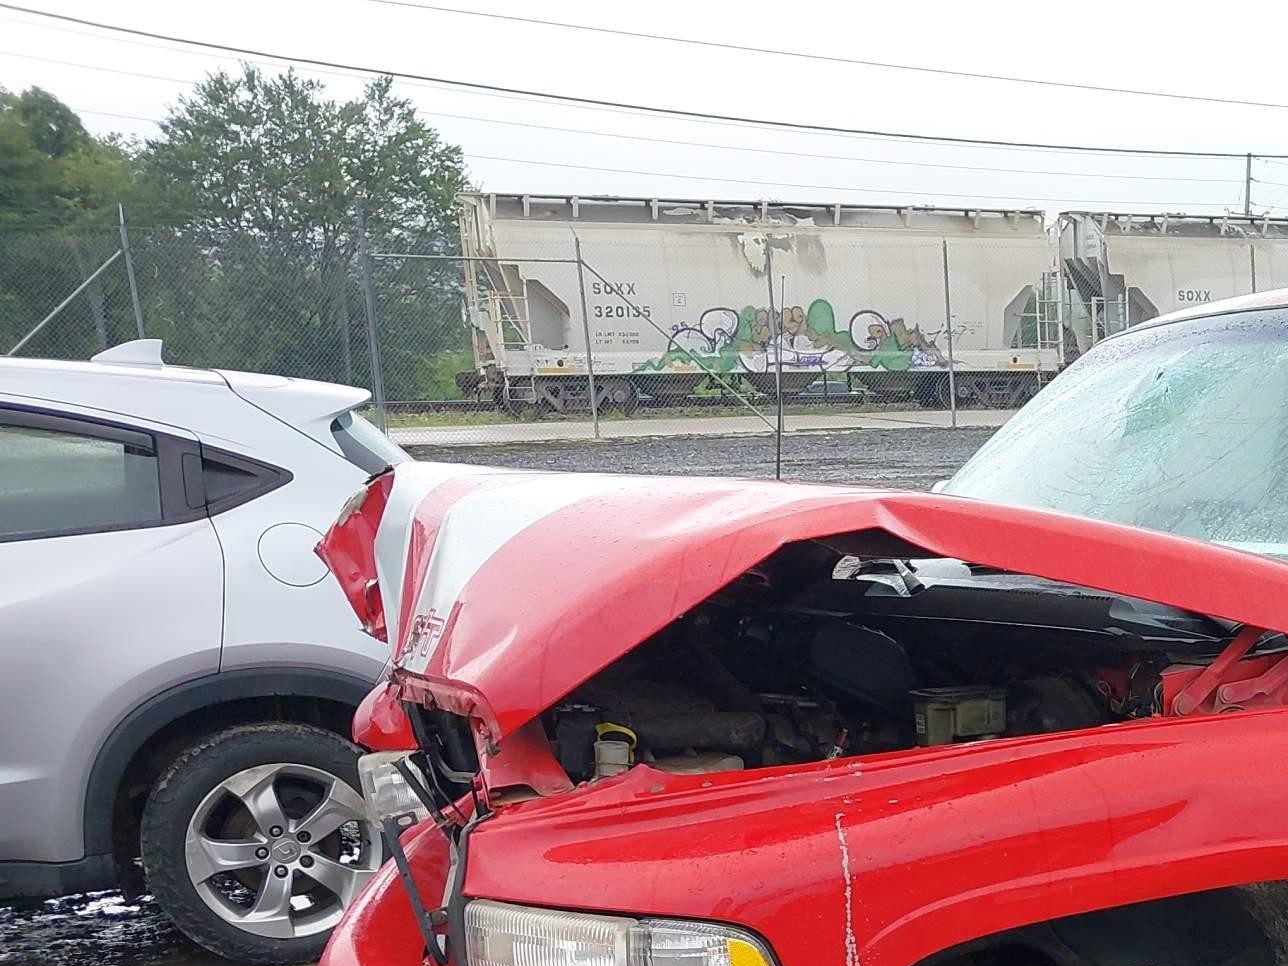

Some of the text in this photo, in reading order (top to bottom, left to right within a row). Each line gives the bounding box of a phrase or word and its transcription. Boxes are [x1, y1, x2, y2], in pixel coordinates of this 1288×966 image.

[592, 283, 636, 295] SOXX
[1177, 290, 1210, 301] SOXX
[594, 305, 651, 318] 320135
